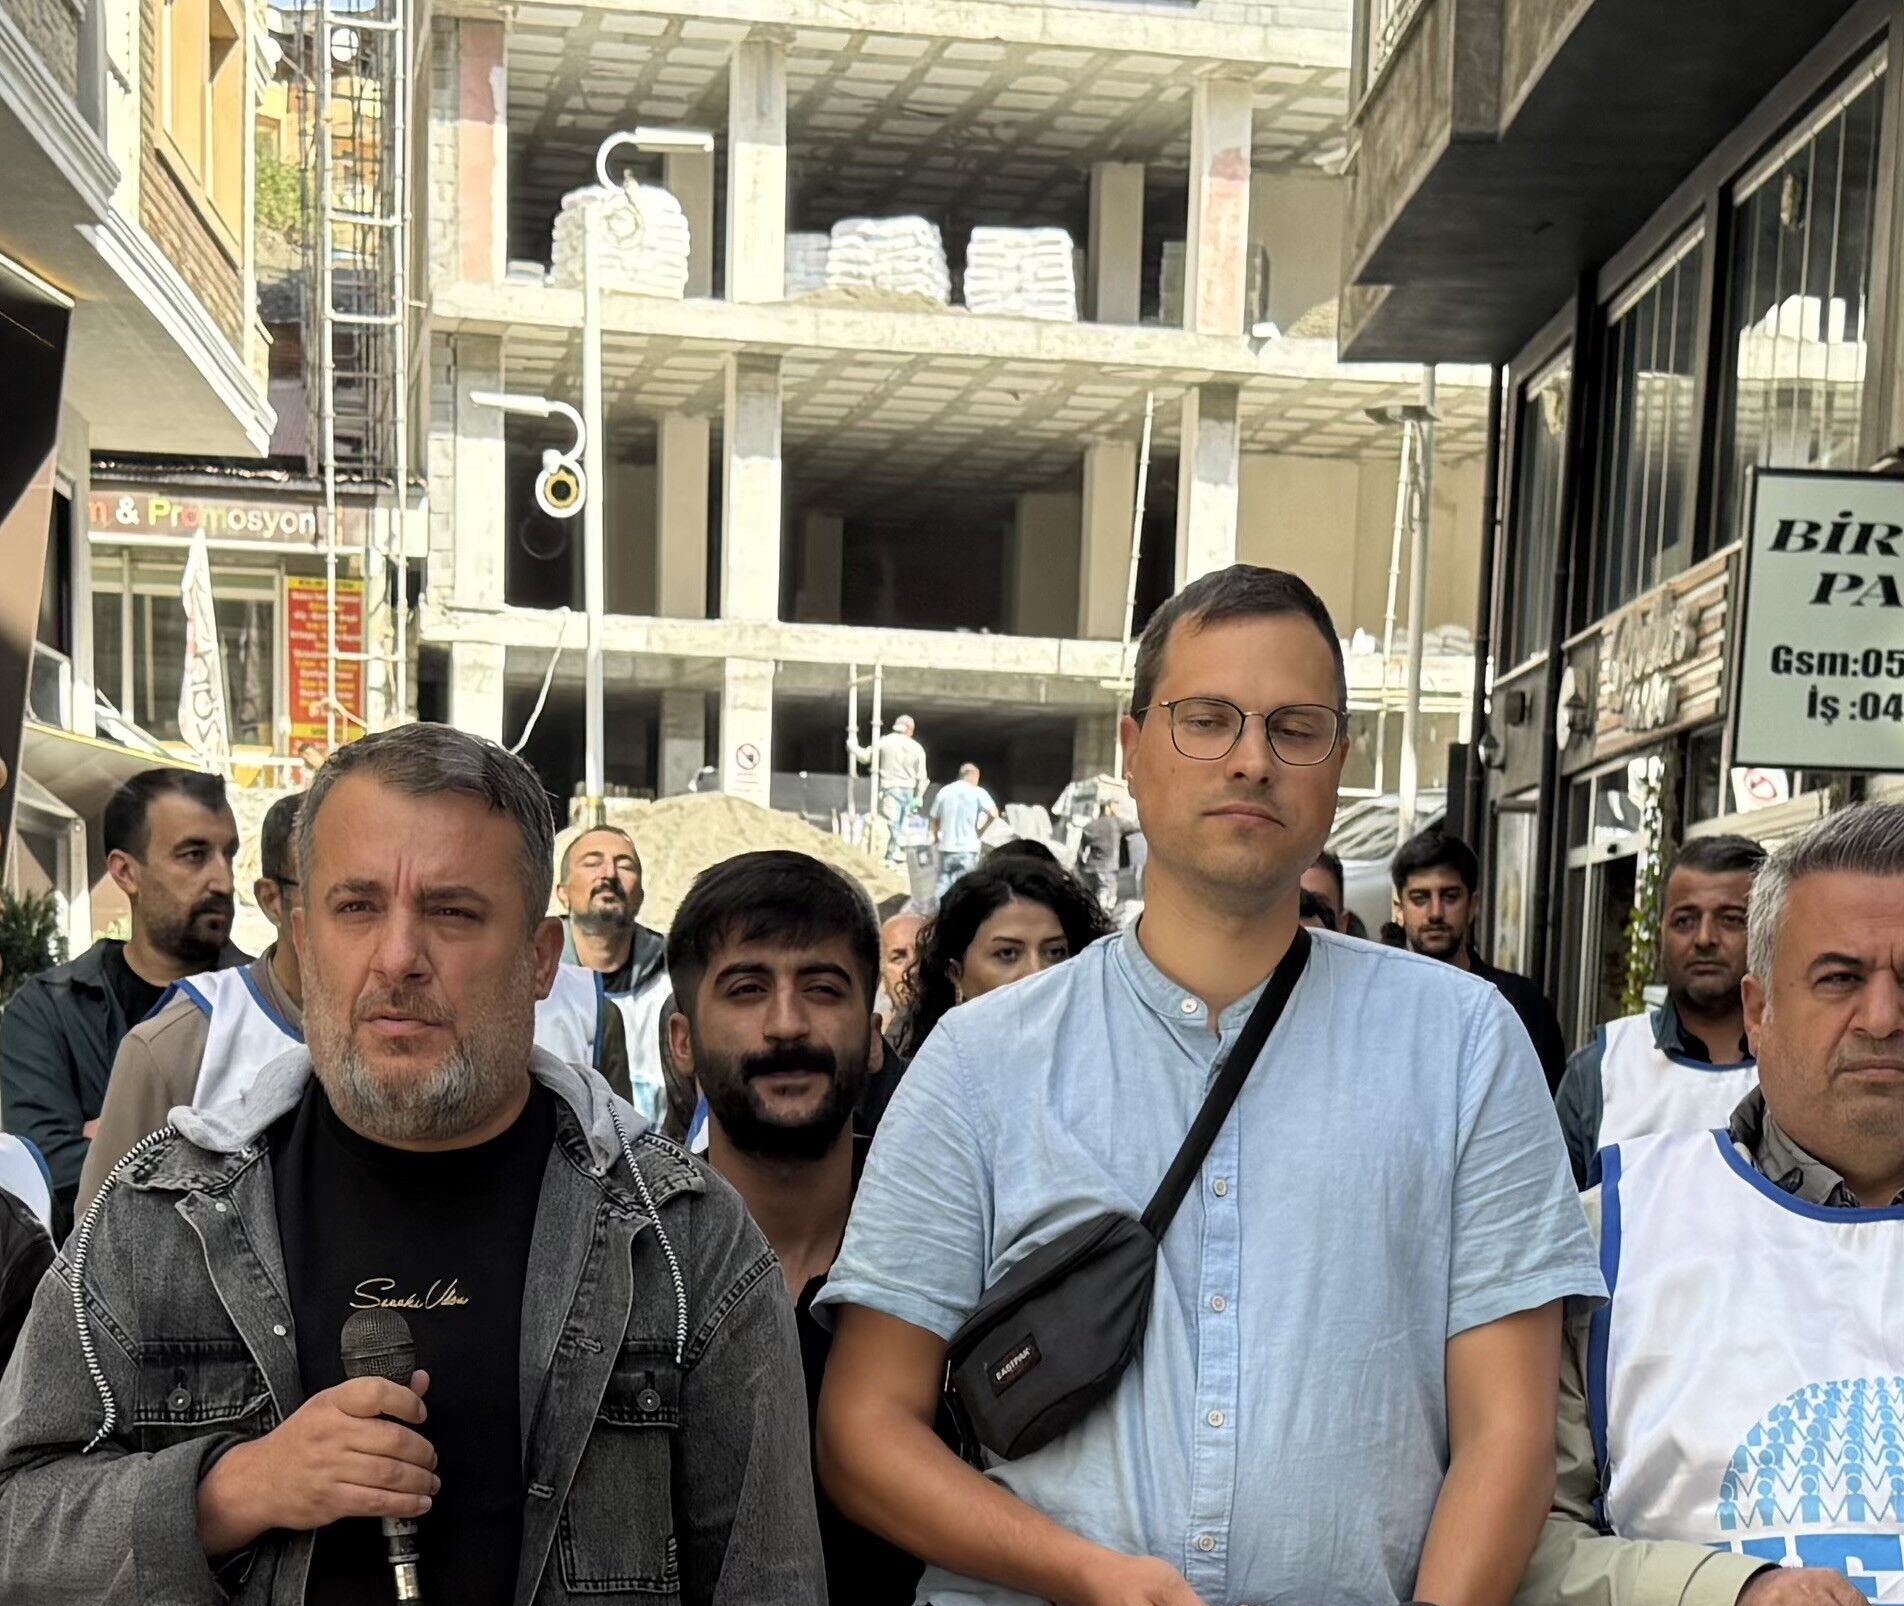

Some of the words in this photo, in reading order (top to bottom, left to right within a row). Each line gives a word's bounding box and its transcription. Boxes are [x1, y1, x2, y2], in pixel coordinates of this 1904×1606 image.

[148, 499, 317, 537] Promosyon
[1807, 685, 1840, 730] İş
[995, 1346, 1032, 1382] EASTPAK
